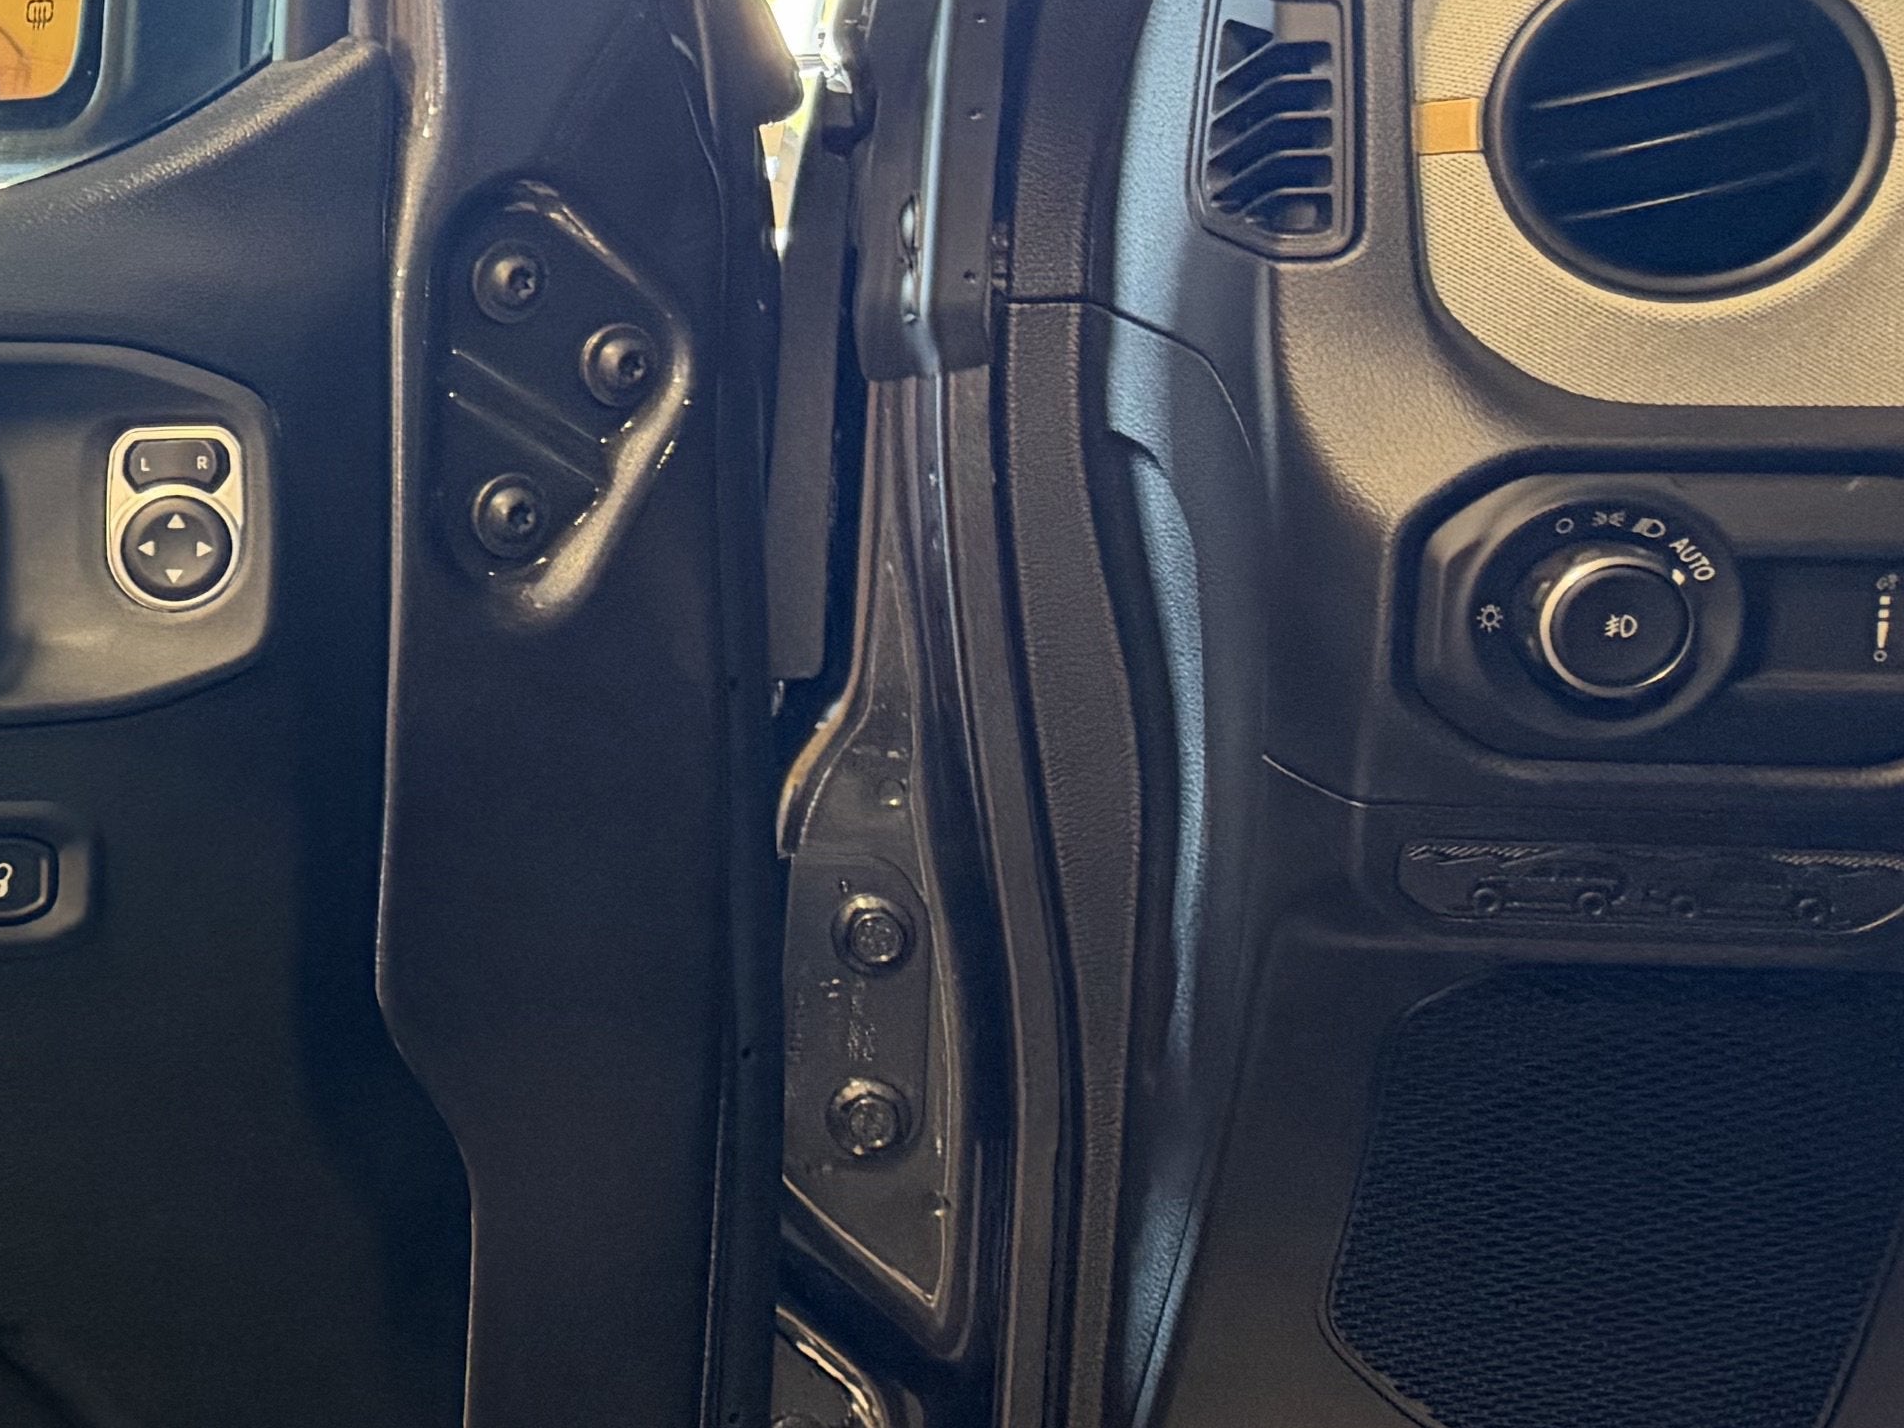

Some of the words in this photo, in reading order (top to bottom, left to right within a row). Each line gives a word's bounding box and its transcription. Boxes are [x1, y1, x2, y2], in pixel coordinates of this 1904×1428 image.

[140, 457, 151, 472] L
[196, 455, 209, 471] R
[1668, 537, 1716, 581] AUTO
